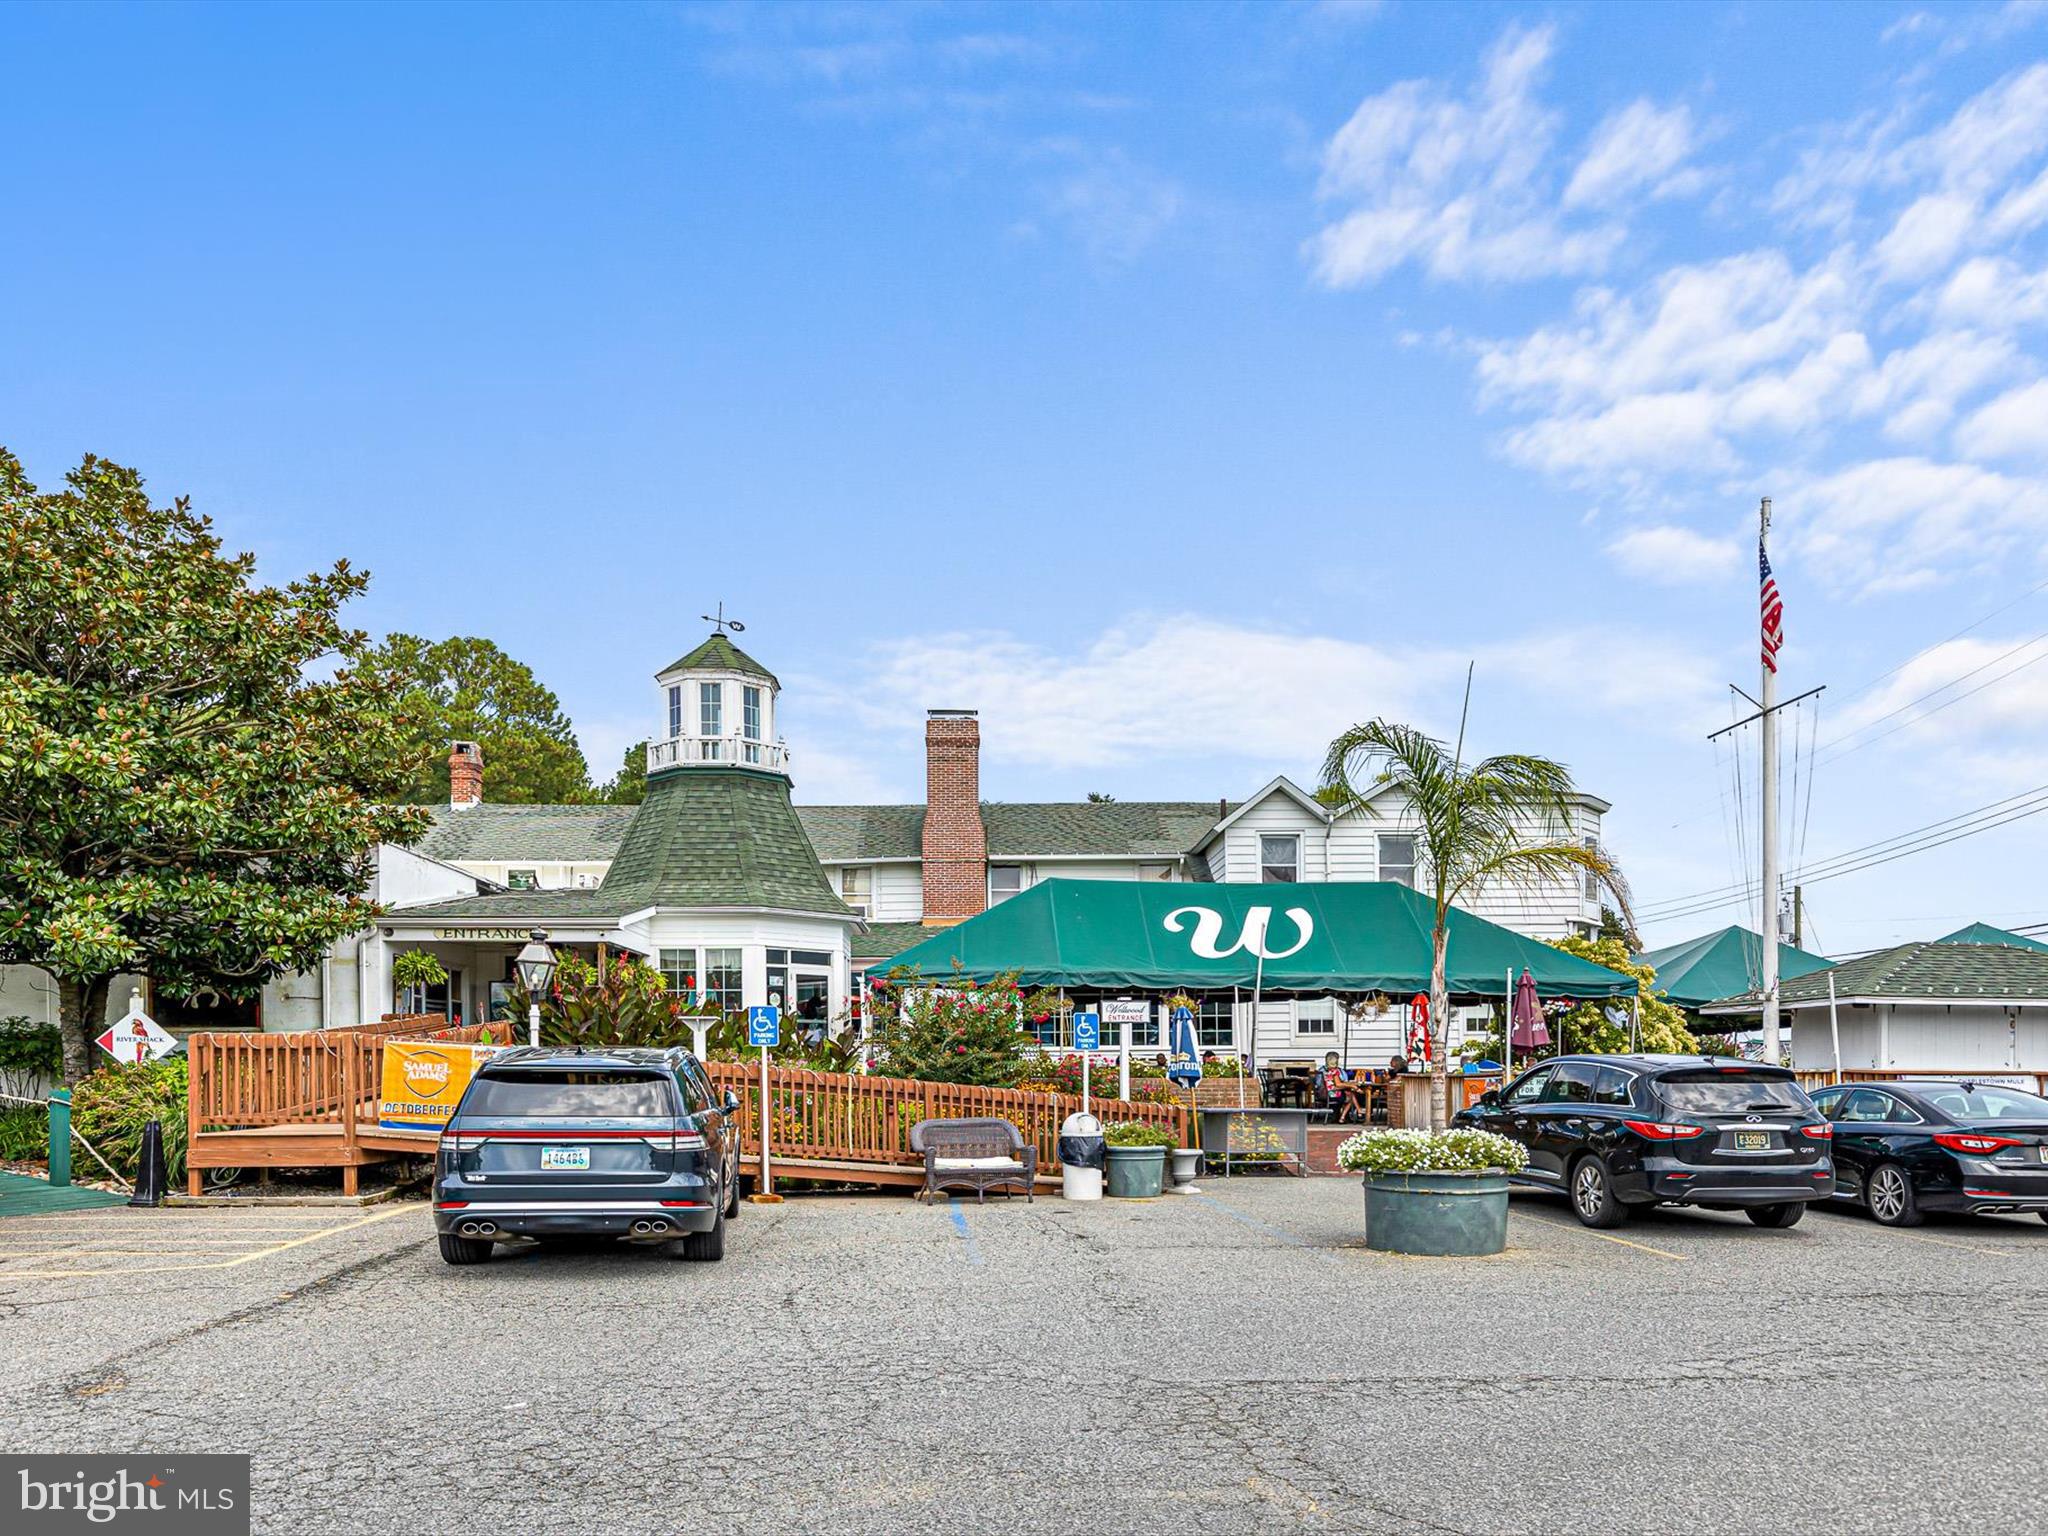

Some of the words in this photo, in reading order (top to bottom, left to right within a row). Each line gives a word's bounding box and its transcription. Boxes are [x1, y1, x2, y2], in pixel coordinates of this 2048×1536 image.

[443, 929, 531, 939] ENTRANC
[1106, 1002, 1146, 1014] Wellwood
[403, 1060, 452, 1074] SAMUEL
[407, 1071, 447, 1082] ADAMS
[384, 1103, 457, 1116] OCTOBERFES
